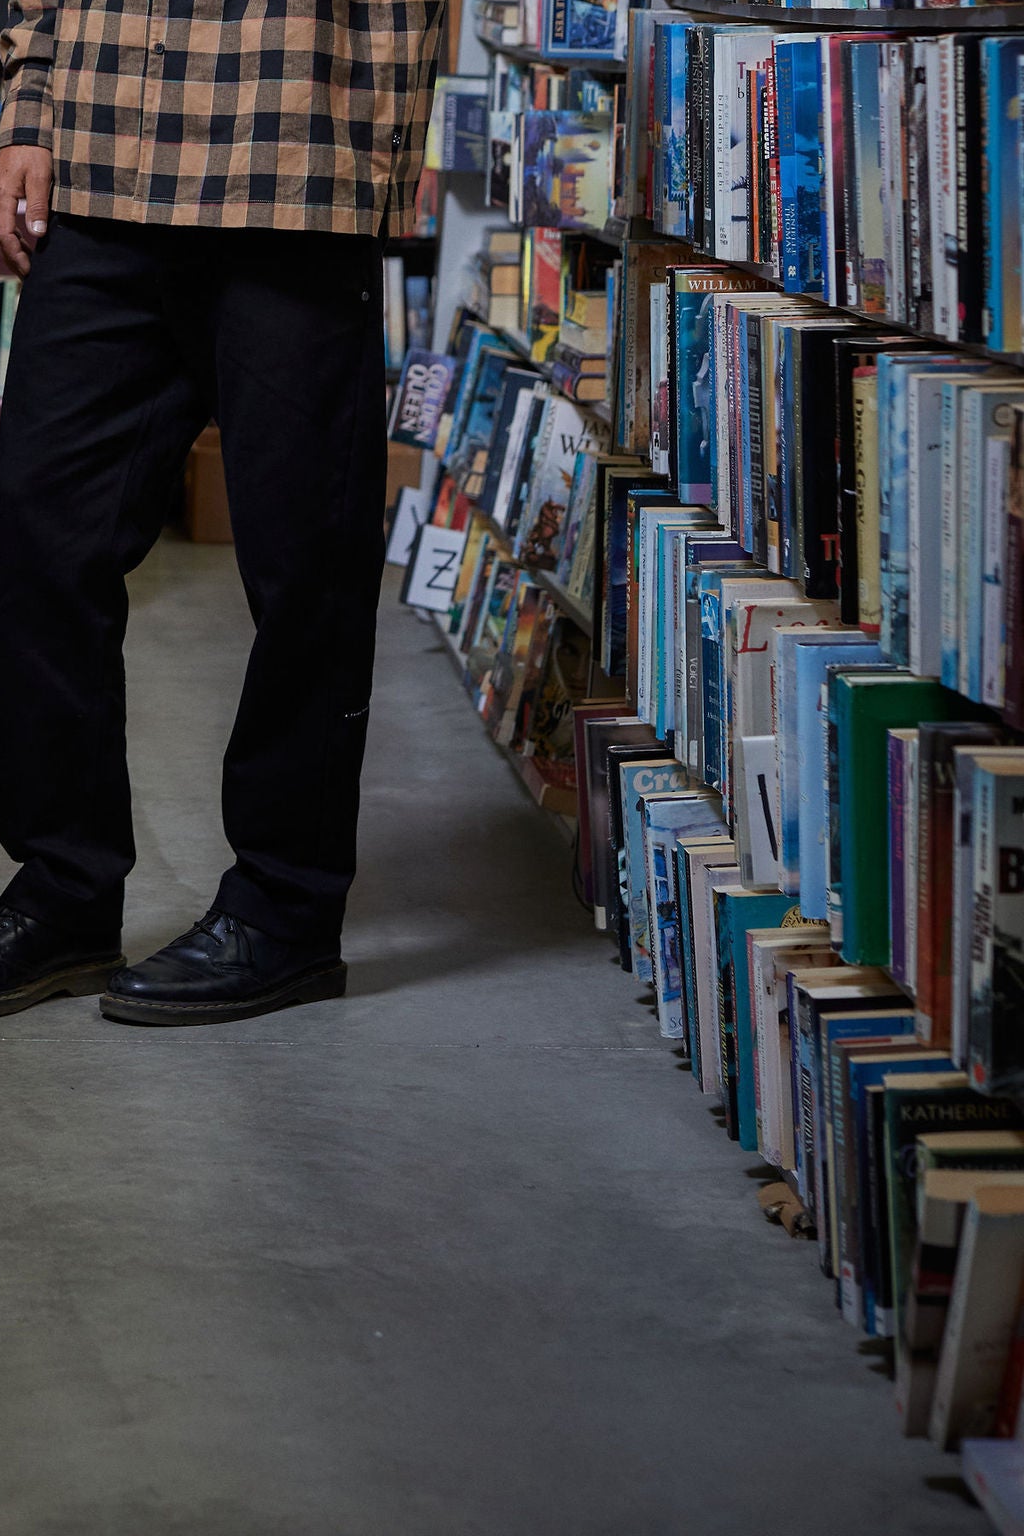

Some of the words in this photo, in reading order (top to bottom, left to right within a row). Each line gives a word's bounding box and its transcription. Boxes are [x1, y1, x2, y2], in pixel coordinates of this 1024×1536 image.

[556, 9, 566, 40] WEST
[939, 43, 948, 108] HARD
[956, 44, 965, 127] SOMEONE
[768, 98, 776, 158] THIRLWELL
[941, 113, 951, 197] MONEY
[957, 130, 966, 187] ELSE'S
[789, 203, 797, 256] DANIELLE
[911, 198, 920, 293] DARKEST
[958, 190, 968, 254] MONEY
[687, 278, 758, 291] WILLIAM
[627, 311, 635, 364] SECOND
[399, 362, 428, 434] QUEEN
[415, 363, 449, 443] GOLDEN
[748, 385, 761, 454] WINTER
[942, 395, 951, 432] How
[854, 398, 864, 465] Dress
[751, 462, 763, 503] FIRE
[854, 468, 865, 524] Gray
[943, 489, 953, 550] Single
[426, 548, 457, 592] Z
[689, 656, 698, 691] VOIGT
[972, 892, 985, 964] PUNCHES
[982, 883, 992, 937] BORN
[718, 982, 727, 1058] JUDGEMENT
[831, 1055, 844, 1108] DESERT
[801, 1069, 814, 1154] DECEPTIONS
[834, 1111, 845, 1146] LOST
[900, 1104, 1009, 1121] KATHERINE
